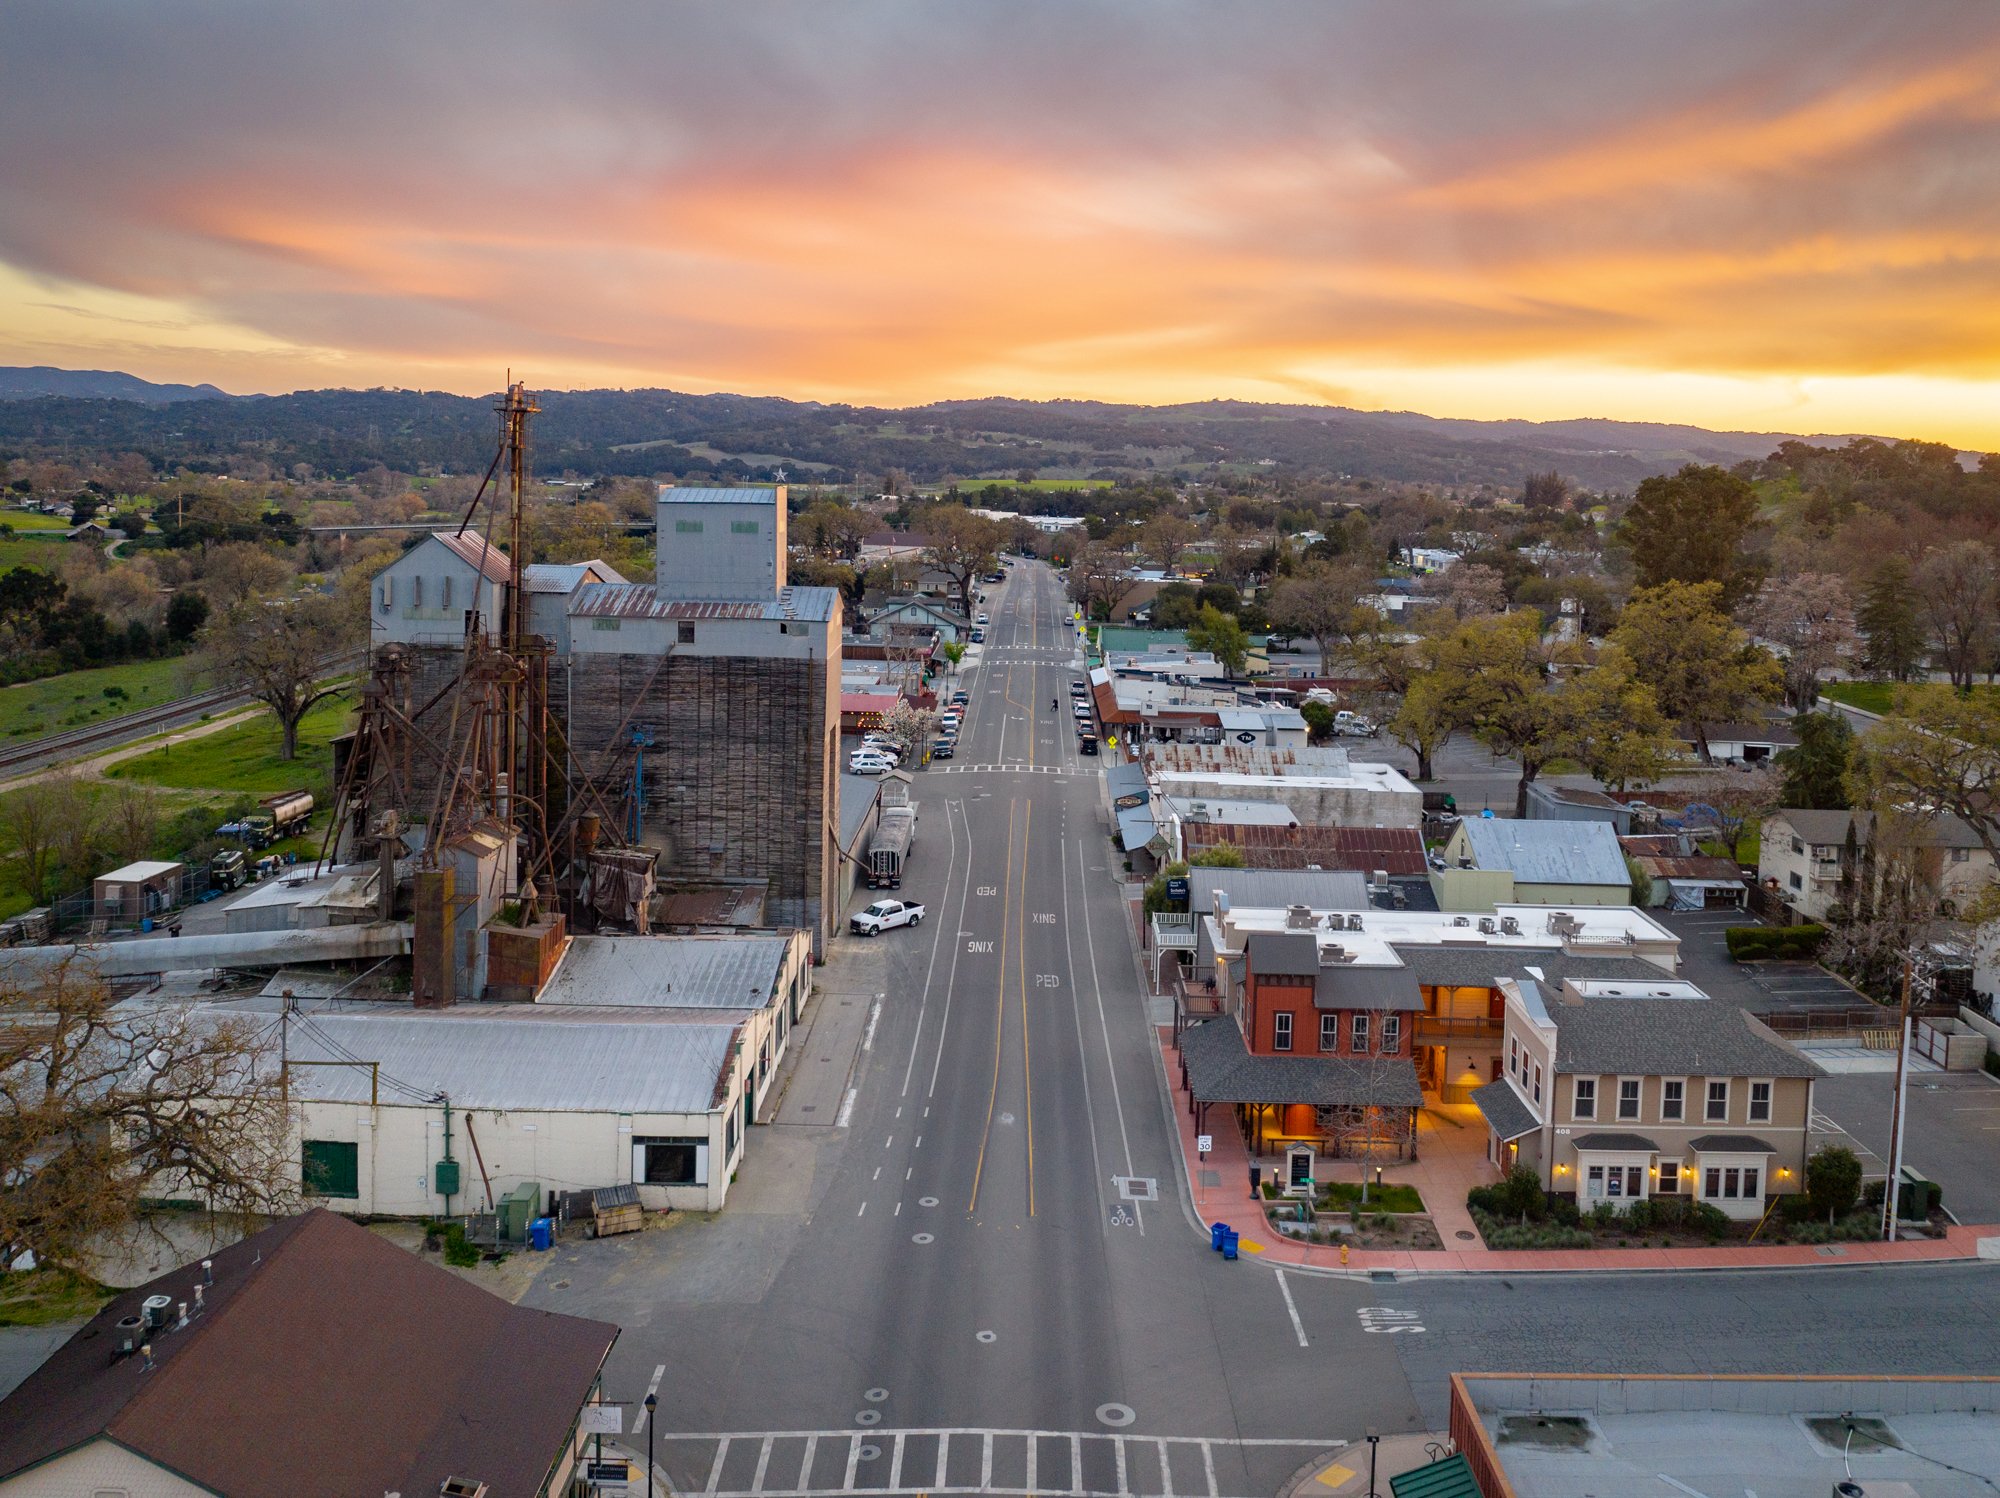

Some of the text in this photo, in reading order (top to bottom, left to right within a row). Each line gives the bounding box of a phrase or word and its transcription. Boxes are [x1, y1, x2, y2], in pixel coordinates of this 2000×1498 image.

[976, 886, 996, 896] PED
[1032, 913, 1056, 924] XING
[968, 941, 993, 953] XING
[1036, 974, 1059, 988] PED
[1356, 1307, 1426, 1333] STOP
[585, 1415, 618, 1425] LASH
